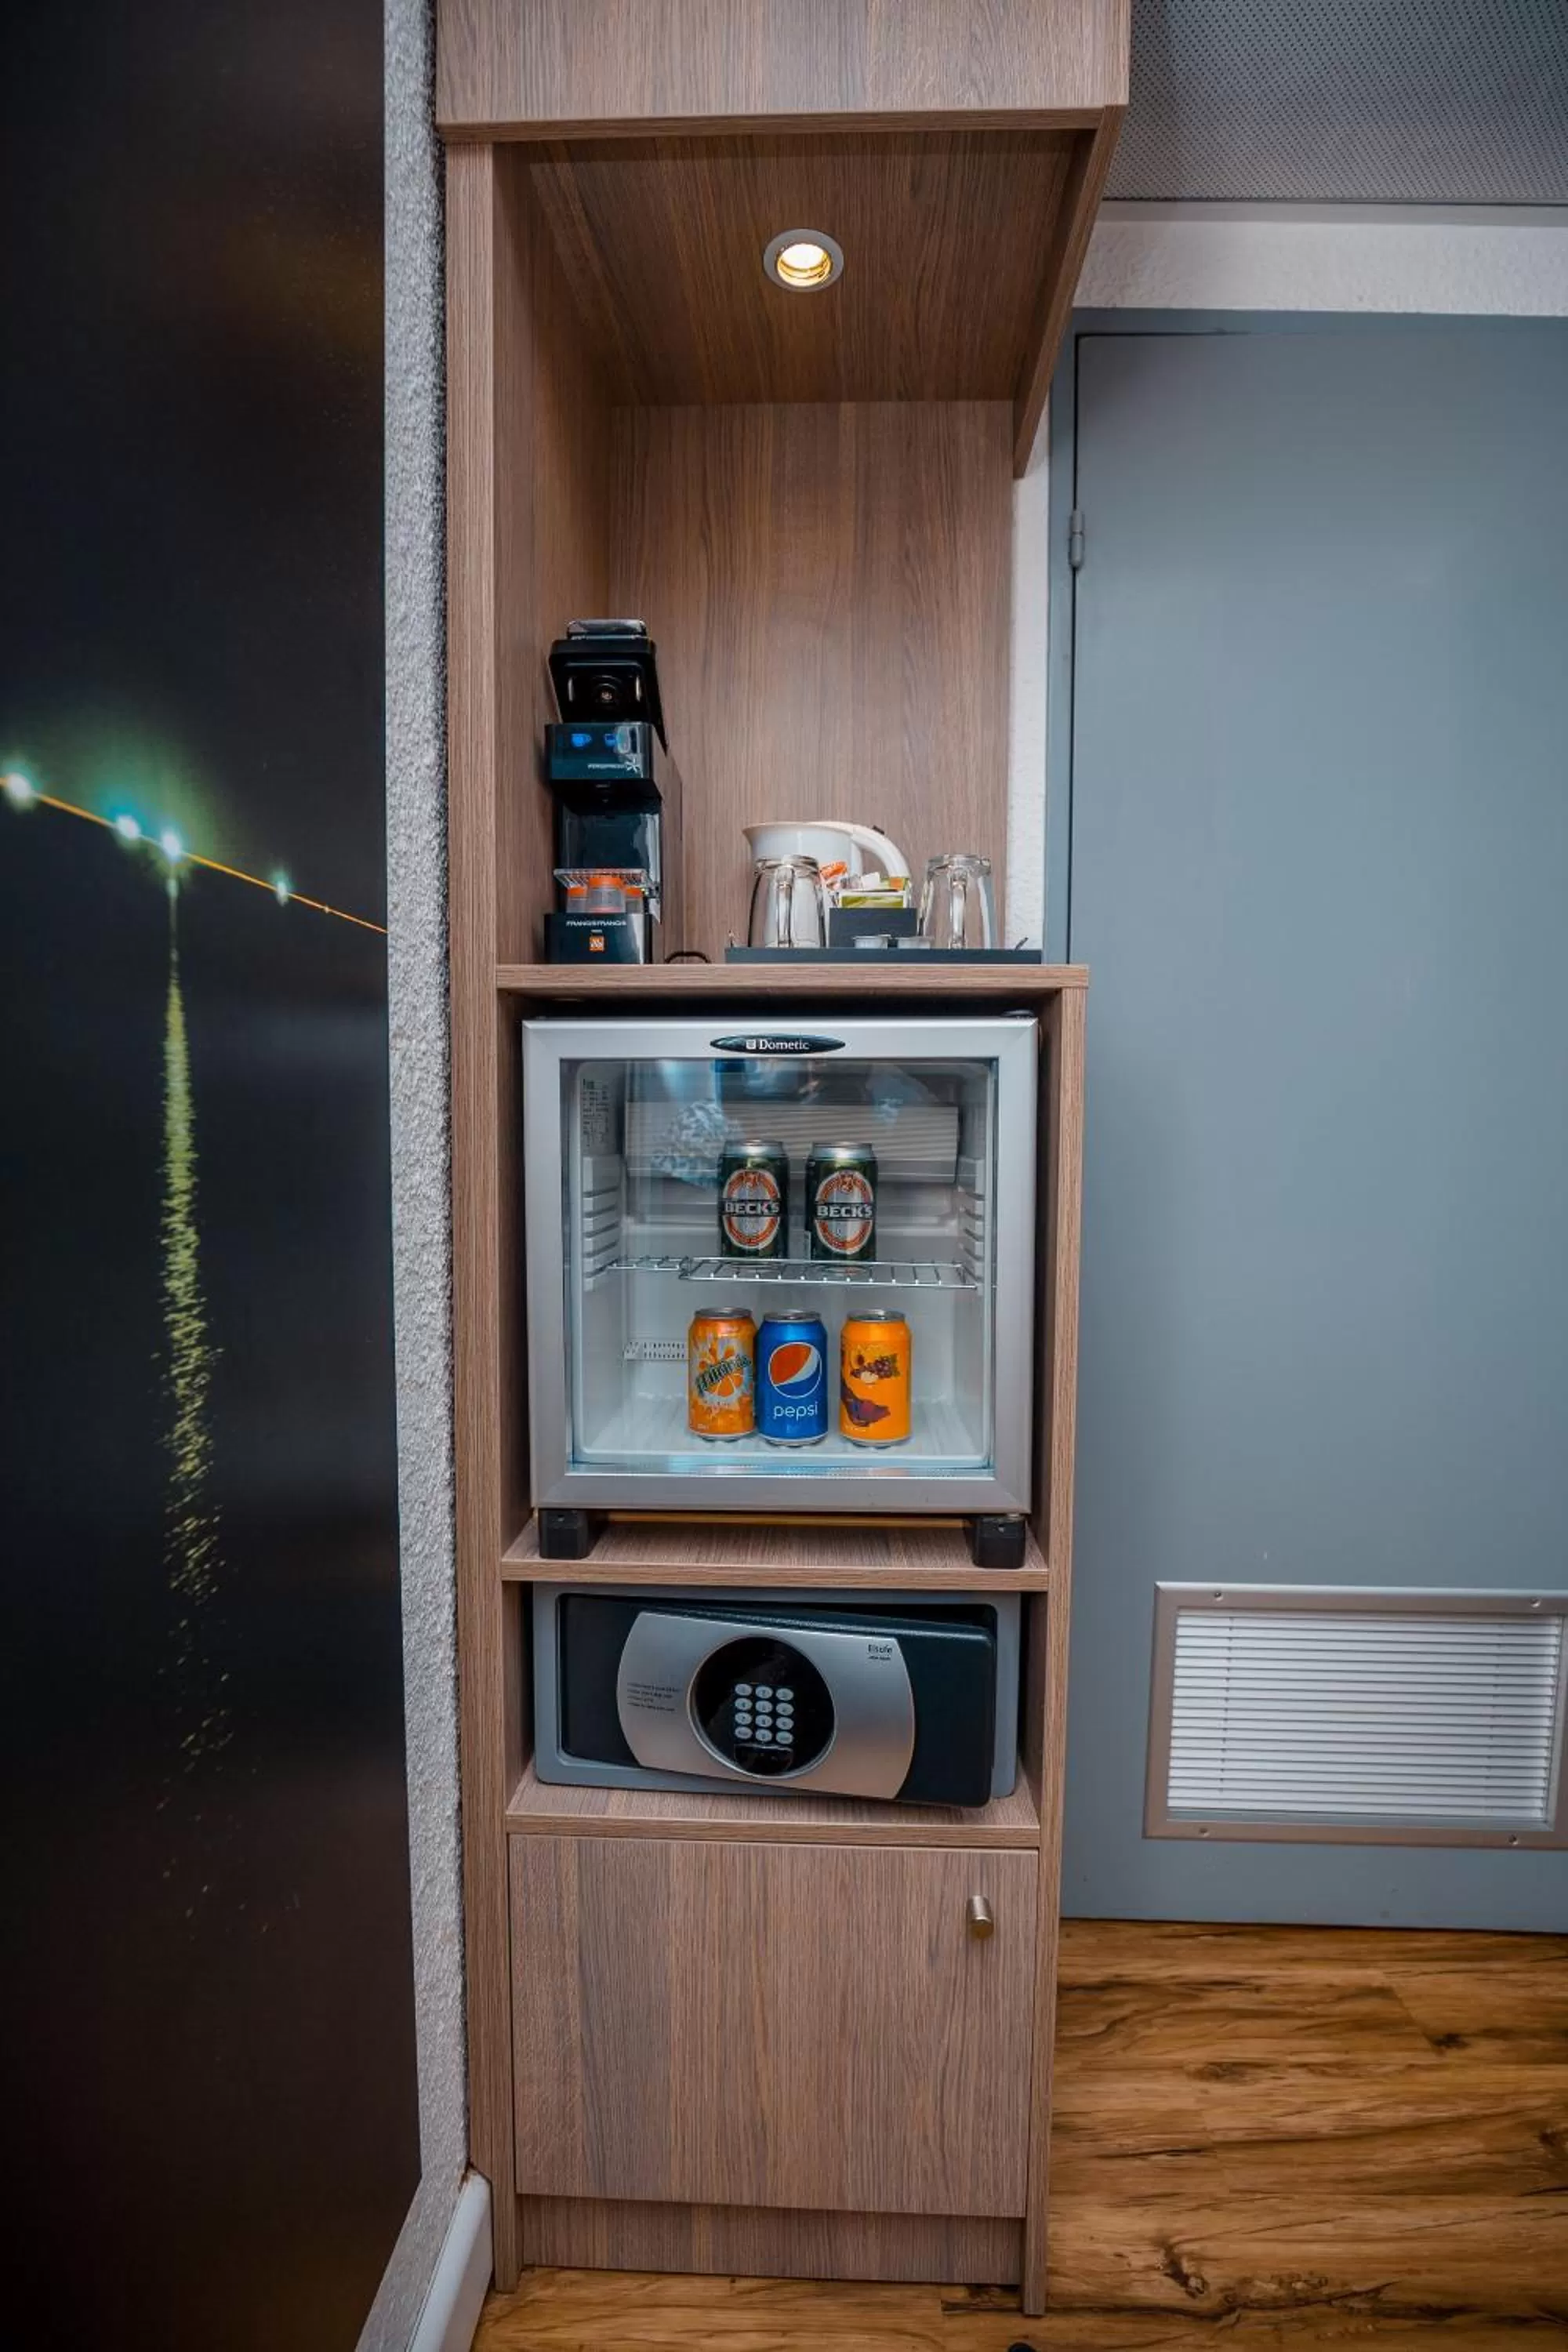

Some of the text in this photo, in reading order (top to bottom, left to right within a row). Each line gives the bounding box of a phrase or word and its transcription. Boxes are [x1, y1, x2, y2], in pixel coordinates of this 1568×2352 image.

[758, 1039, 810, 1050] Dometic
[725, 1201, 780, 1214] BECK'S
[817, 1203, 873, 1218] BECK'S
[773, 1401, 818, 1421] pepsi
